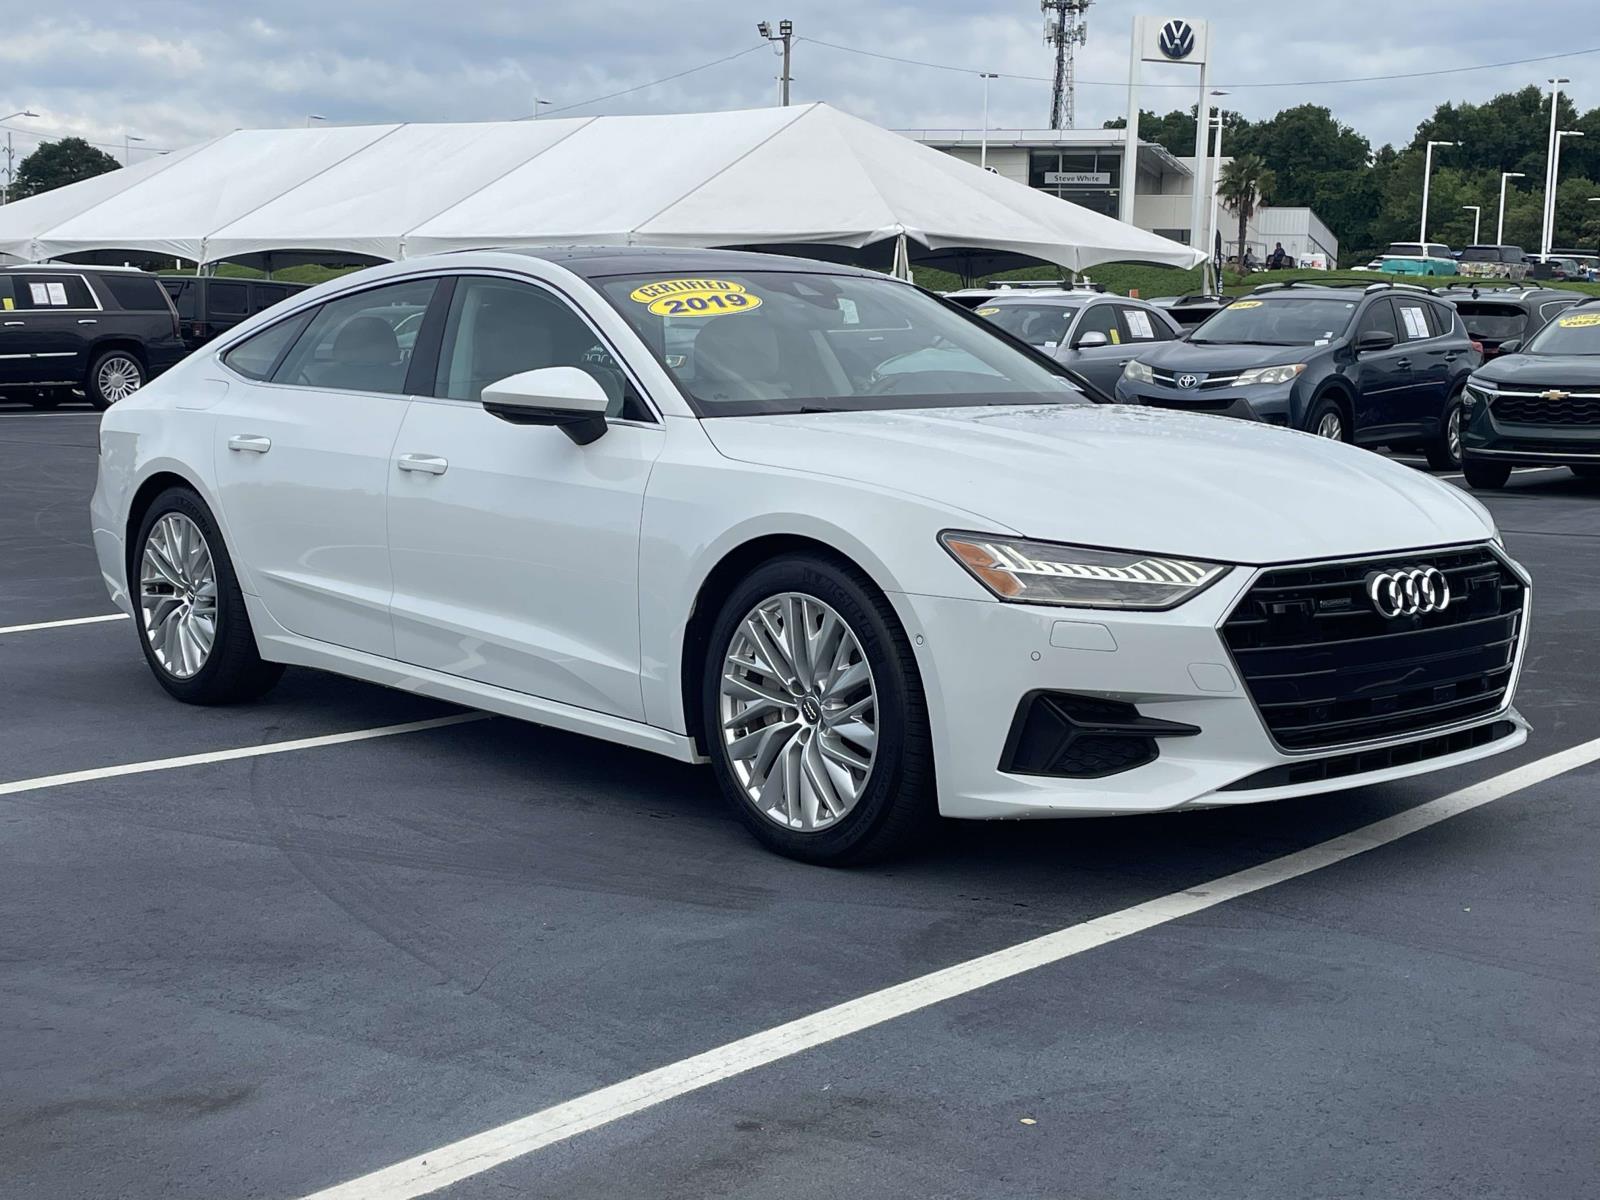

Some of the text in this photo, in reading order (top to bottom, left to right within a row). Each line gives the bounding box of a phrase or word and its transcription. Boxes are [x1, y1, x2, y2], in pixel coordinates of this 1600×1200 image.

[1054, 174, 1075, 182] Steve
[638, 280, 731, 297] CERTIFIED
[663, 294, 749, 314] 2019
